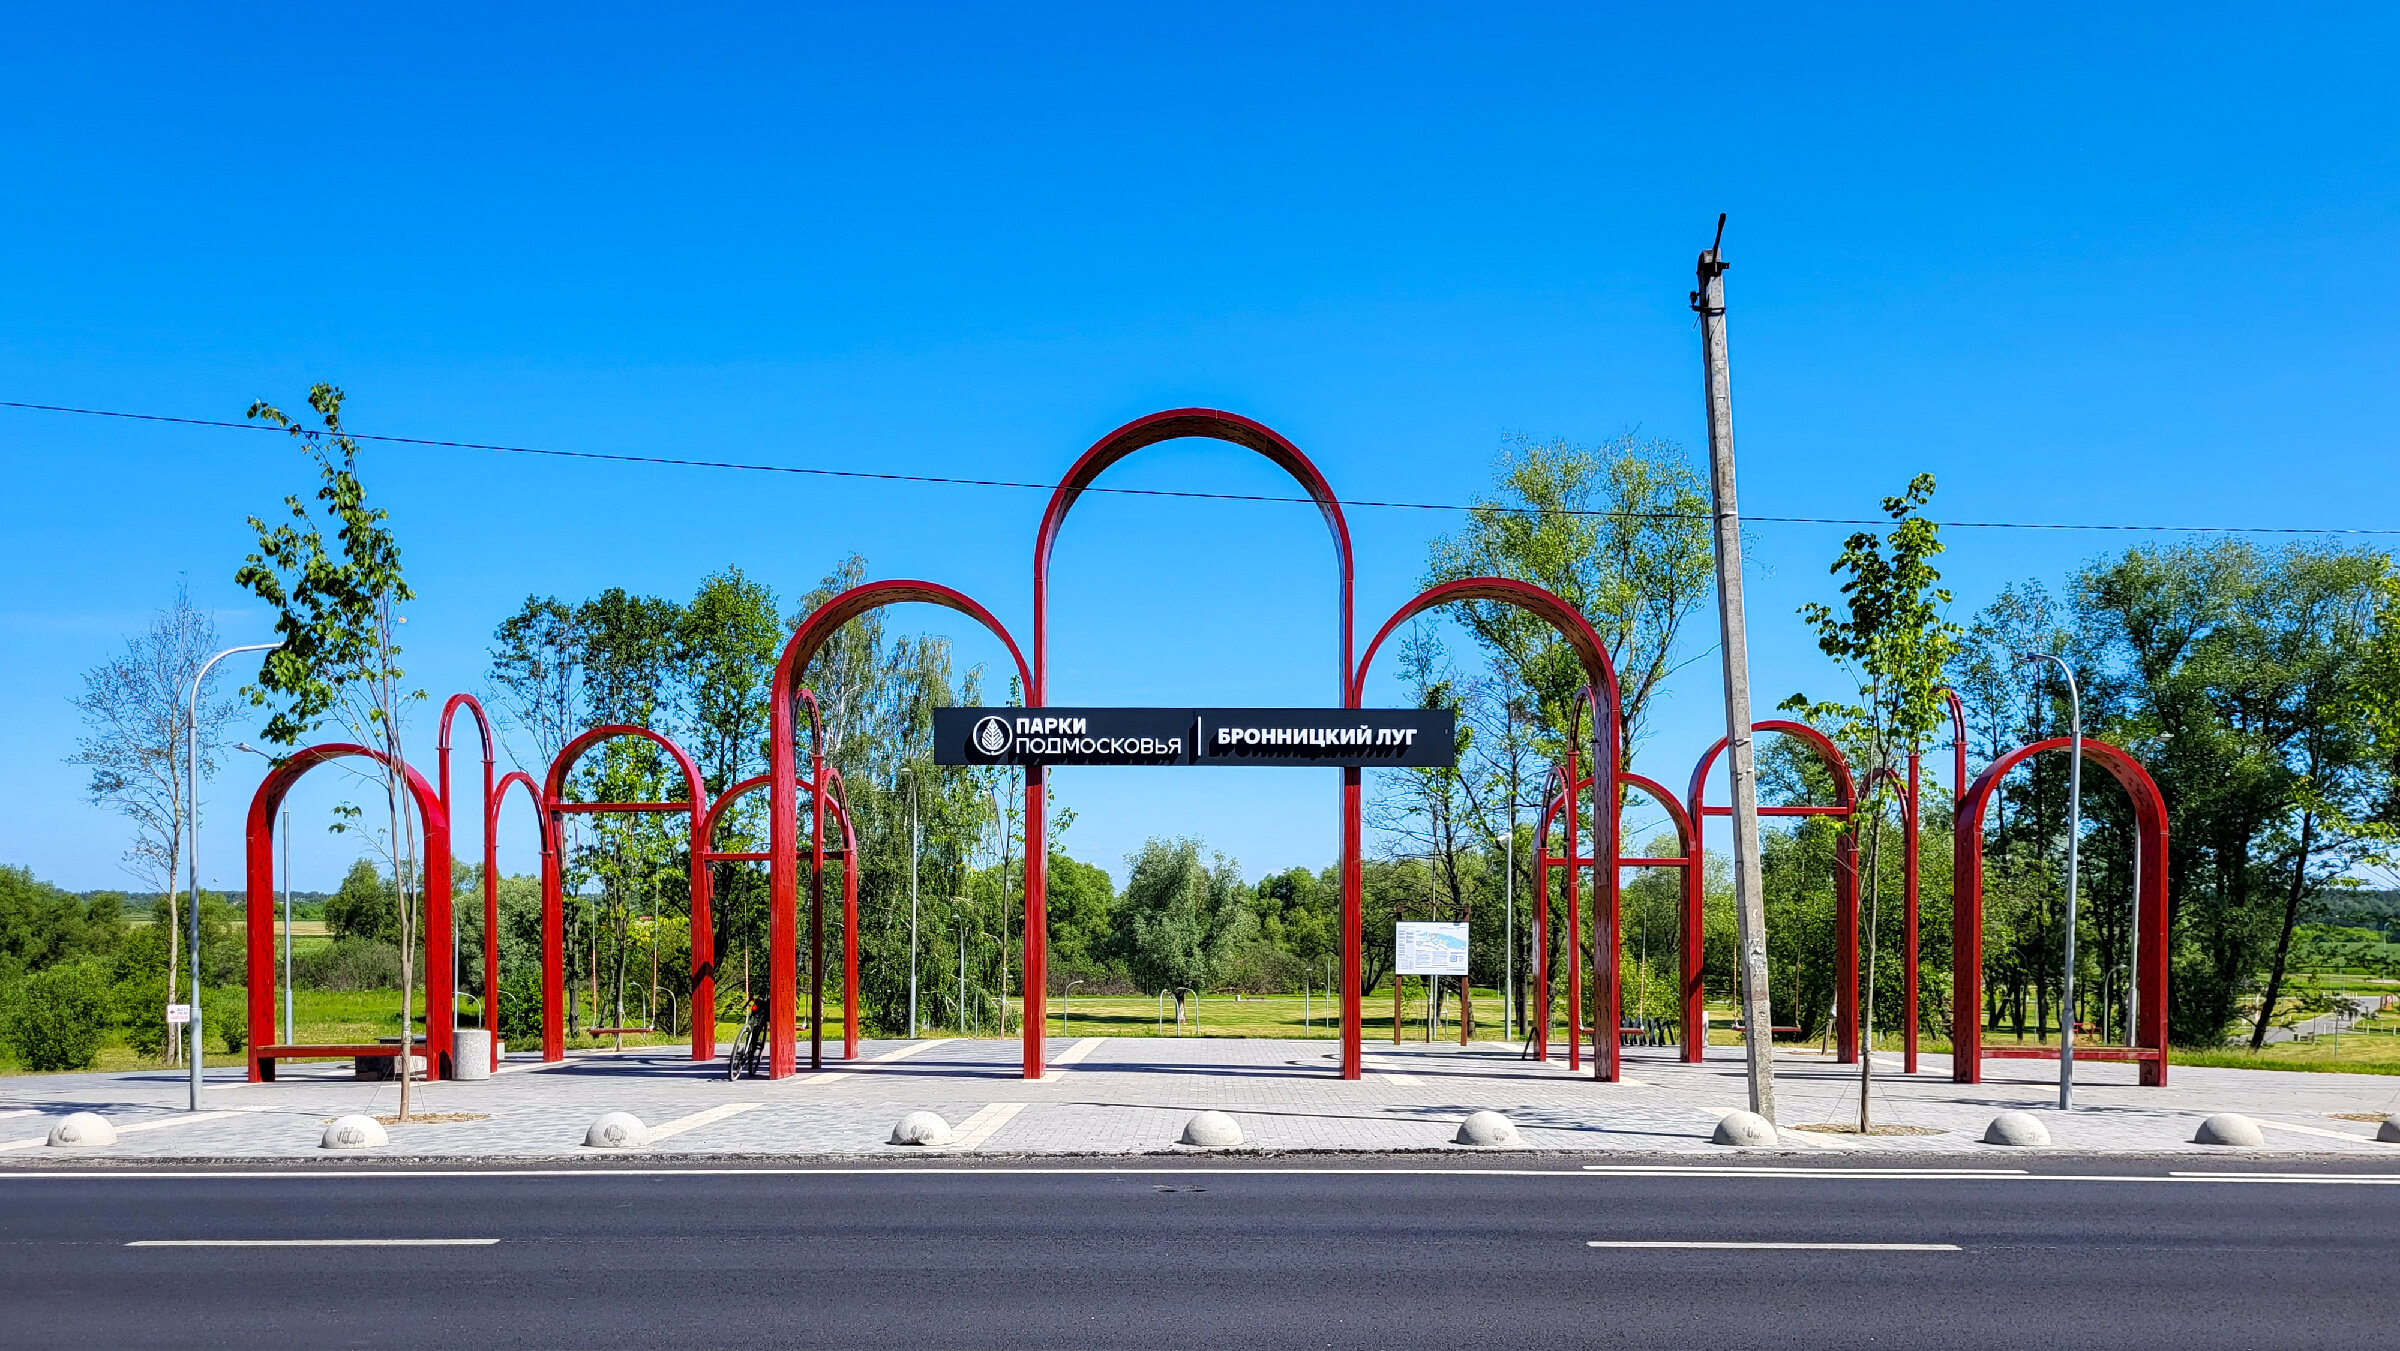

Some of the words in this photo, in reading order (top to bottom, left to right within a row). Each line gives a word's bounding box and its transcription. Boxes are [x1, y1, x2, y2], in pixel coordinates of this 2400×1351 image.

[1016, 717, 1087, 735] ПАРКИ
[1218, 724, 1373, 748] БРОННИЦКИЙ
[1375, 728, 1418, 746] ЛУГ
[1016, 737, 1182, 755] ПОДМОСКОВЬЯ
